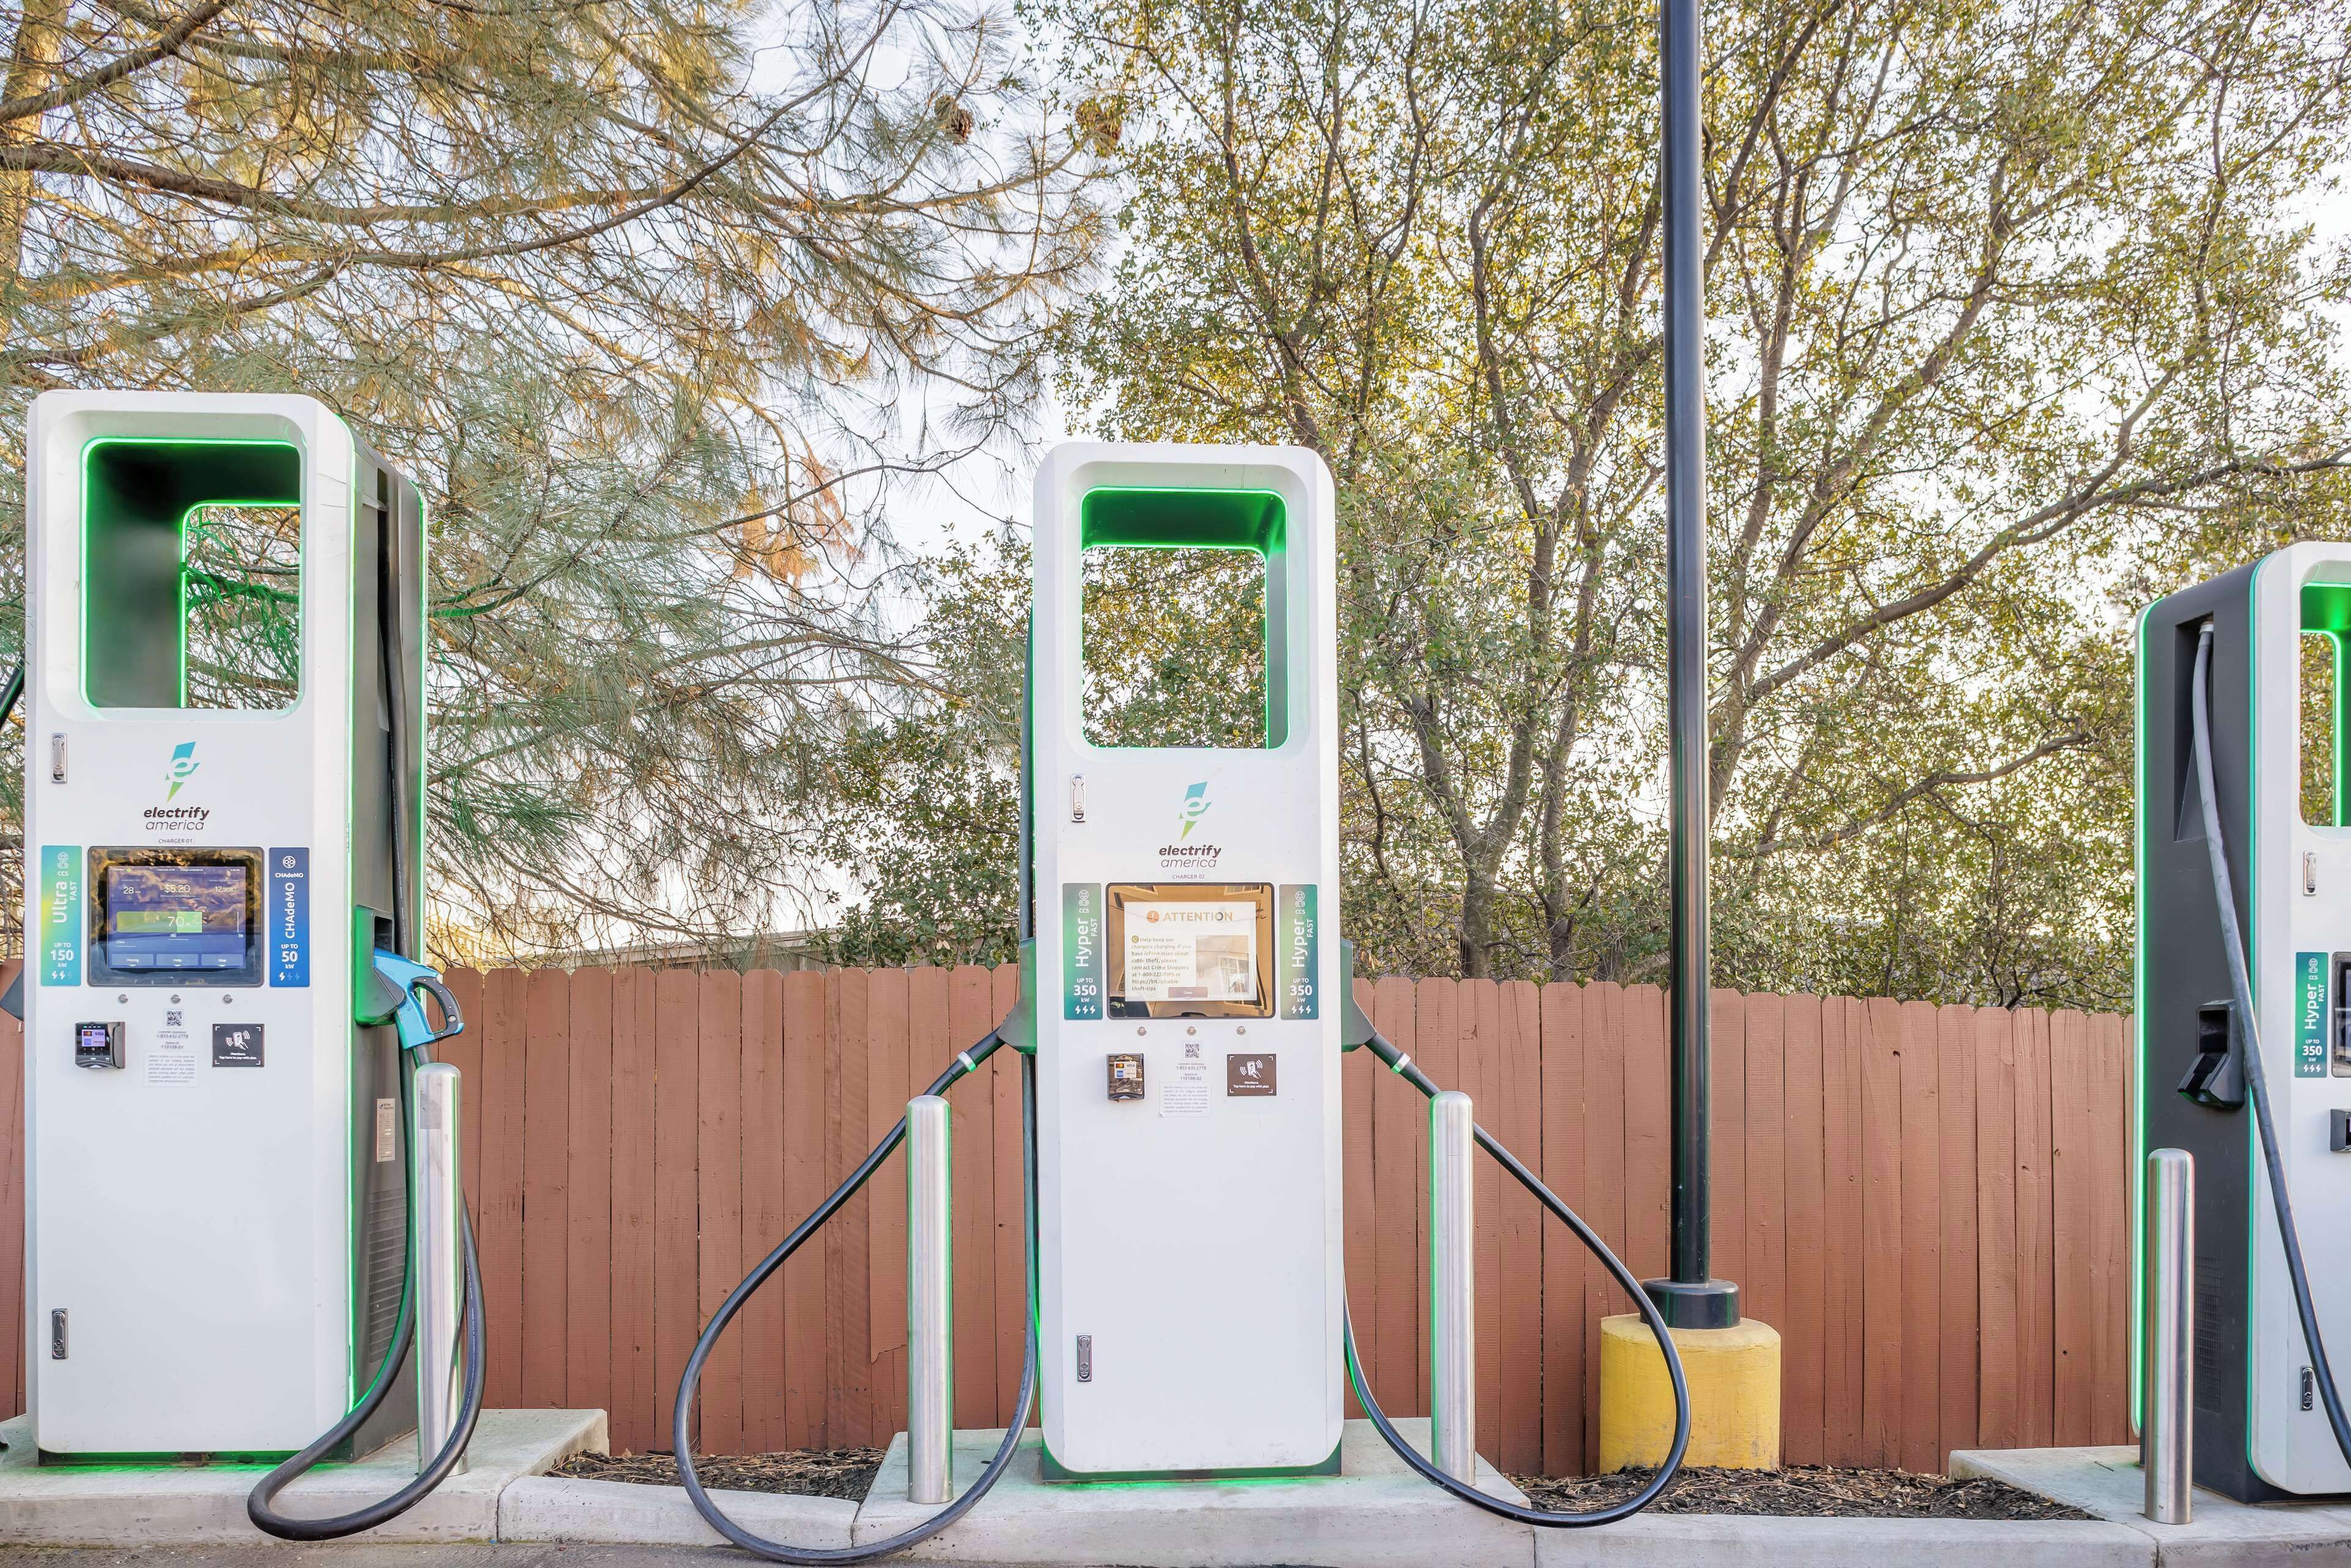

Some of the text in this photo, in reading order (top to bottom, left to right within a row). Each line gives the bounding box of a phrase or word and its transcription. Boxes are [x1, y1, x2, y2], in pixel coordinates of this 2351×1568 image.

[144, 806, 209, 820] electrify
[146, 819, 204, 830] america
[1159, 845, 1222, 857] electrify
[1161, 857, 1217, 868] america
[164, 884, 190, 894] $5.20
[51, 881, 68, 923] Ultra
[284, 882, 295, 939] CHAdeMO
[167, 916, 184, 927] 70
[1163, 912, 1233, 921] ATTENTION
[1075, 917, 1092, 967] Hyper
[1292, 918, 1308, 967] Hyper
[50, 950, 75, 961] 150
[282, 951, 298, 962] 50
[1073, 985, 1097, 996] 350
[1289, 985, 1313, 996] 350
[2304, 983, 2319, 1030] Hyper
[2302, 1046, 2323, 1056] 350
